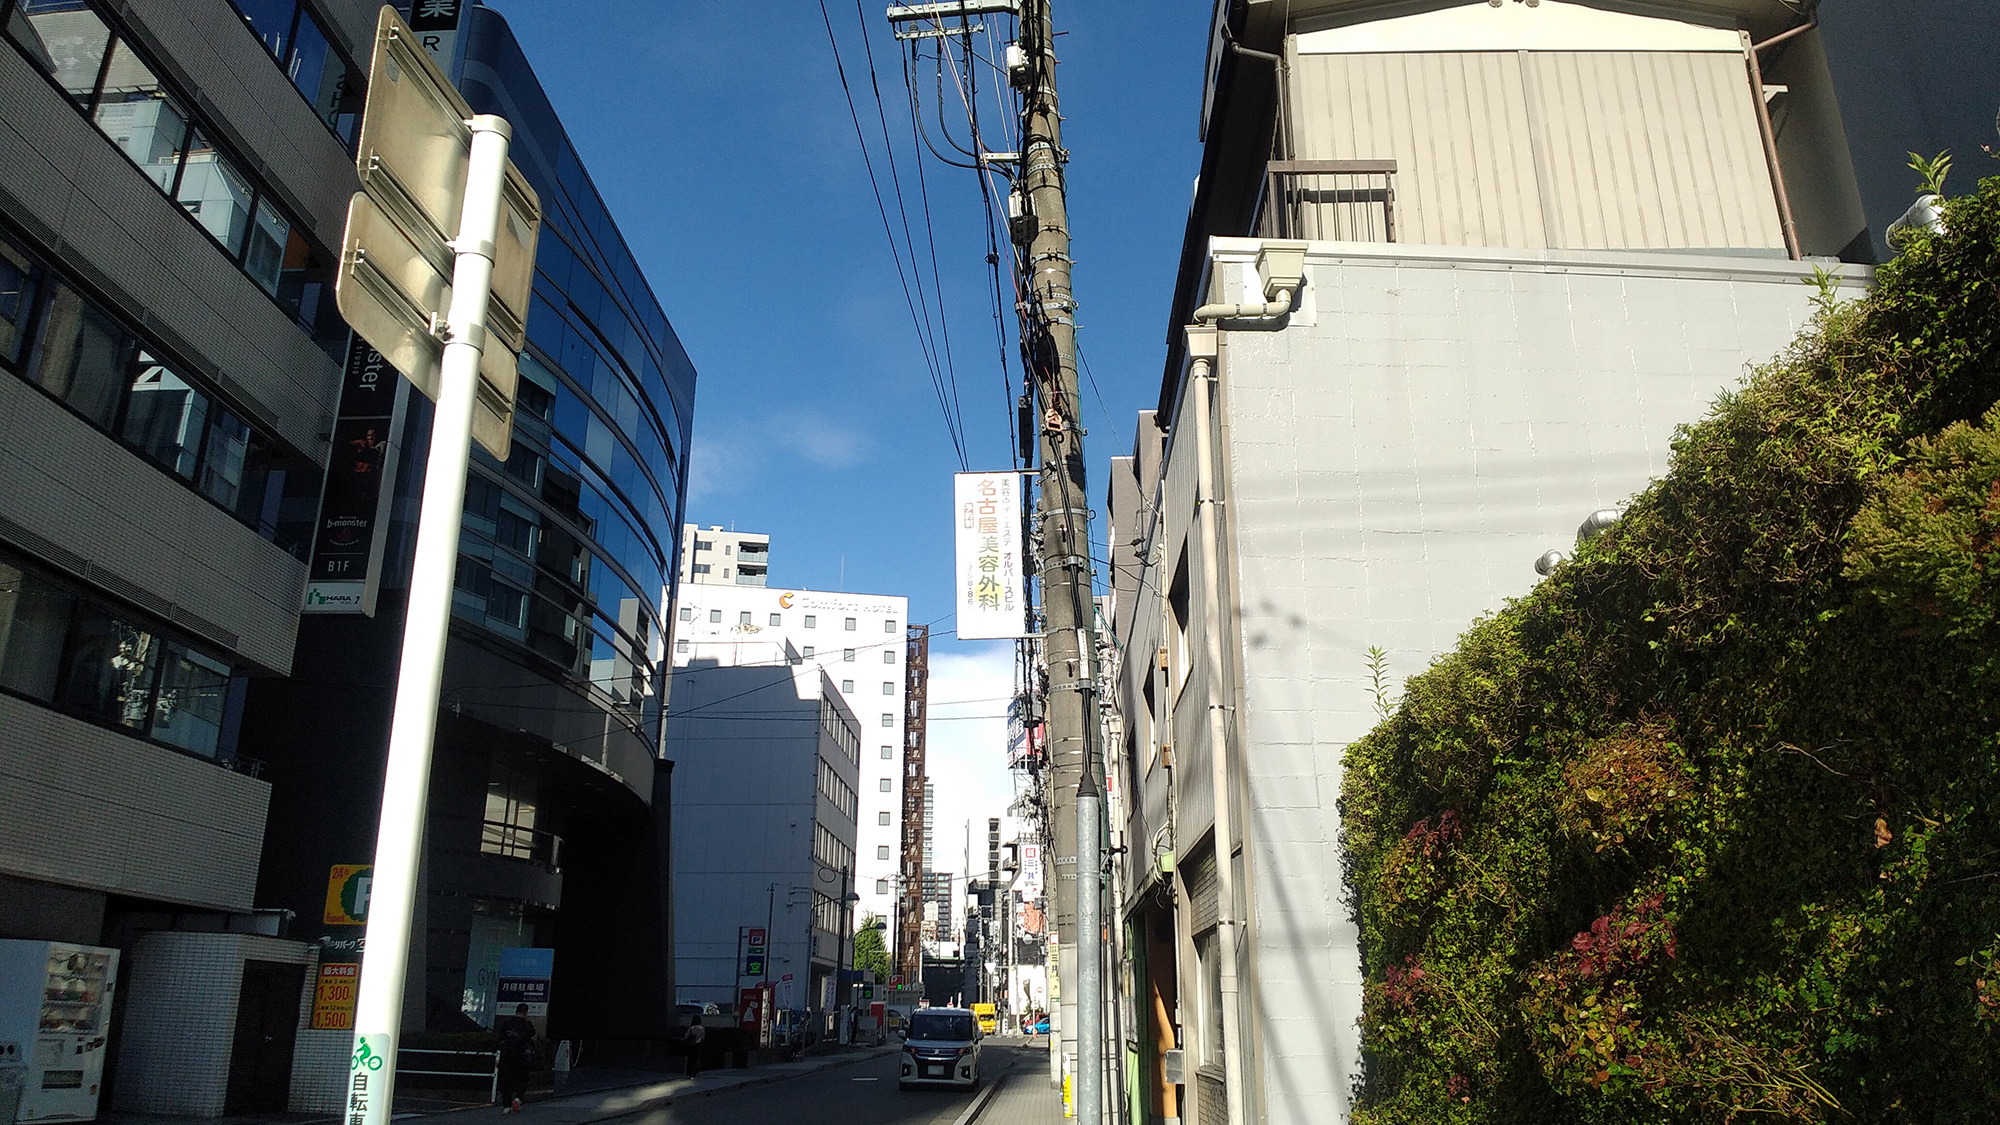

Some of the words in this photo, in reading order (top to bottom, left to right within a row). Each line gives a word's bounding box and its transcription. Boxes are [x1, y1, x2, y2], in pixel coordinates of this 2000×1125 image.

[359, 349, 383, 391] ster
[327, 519, 368, 528] b-monster
[327, 560, 350, 572] B1F
[977, 479, 1000, 612] 名古屋美容外科
[350, 1072, 368, 1125] 自転車
